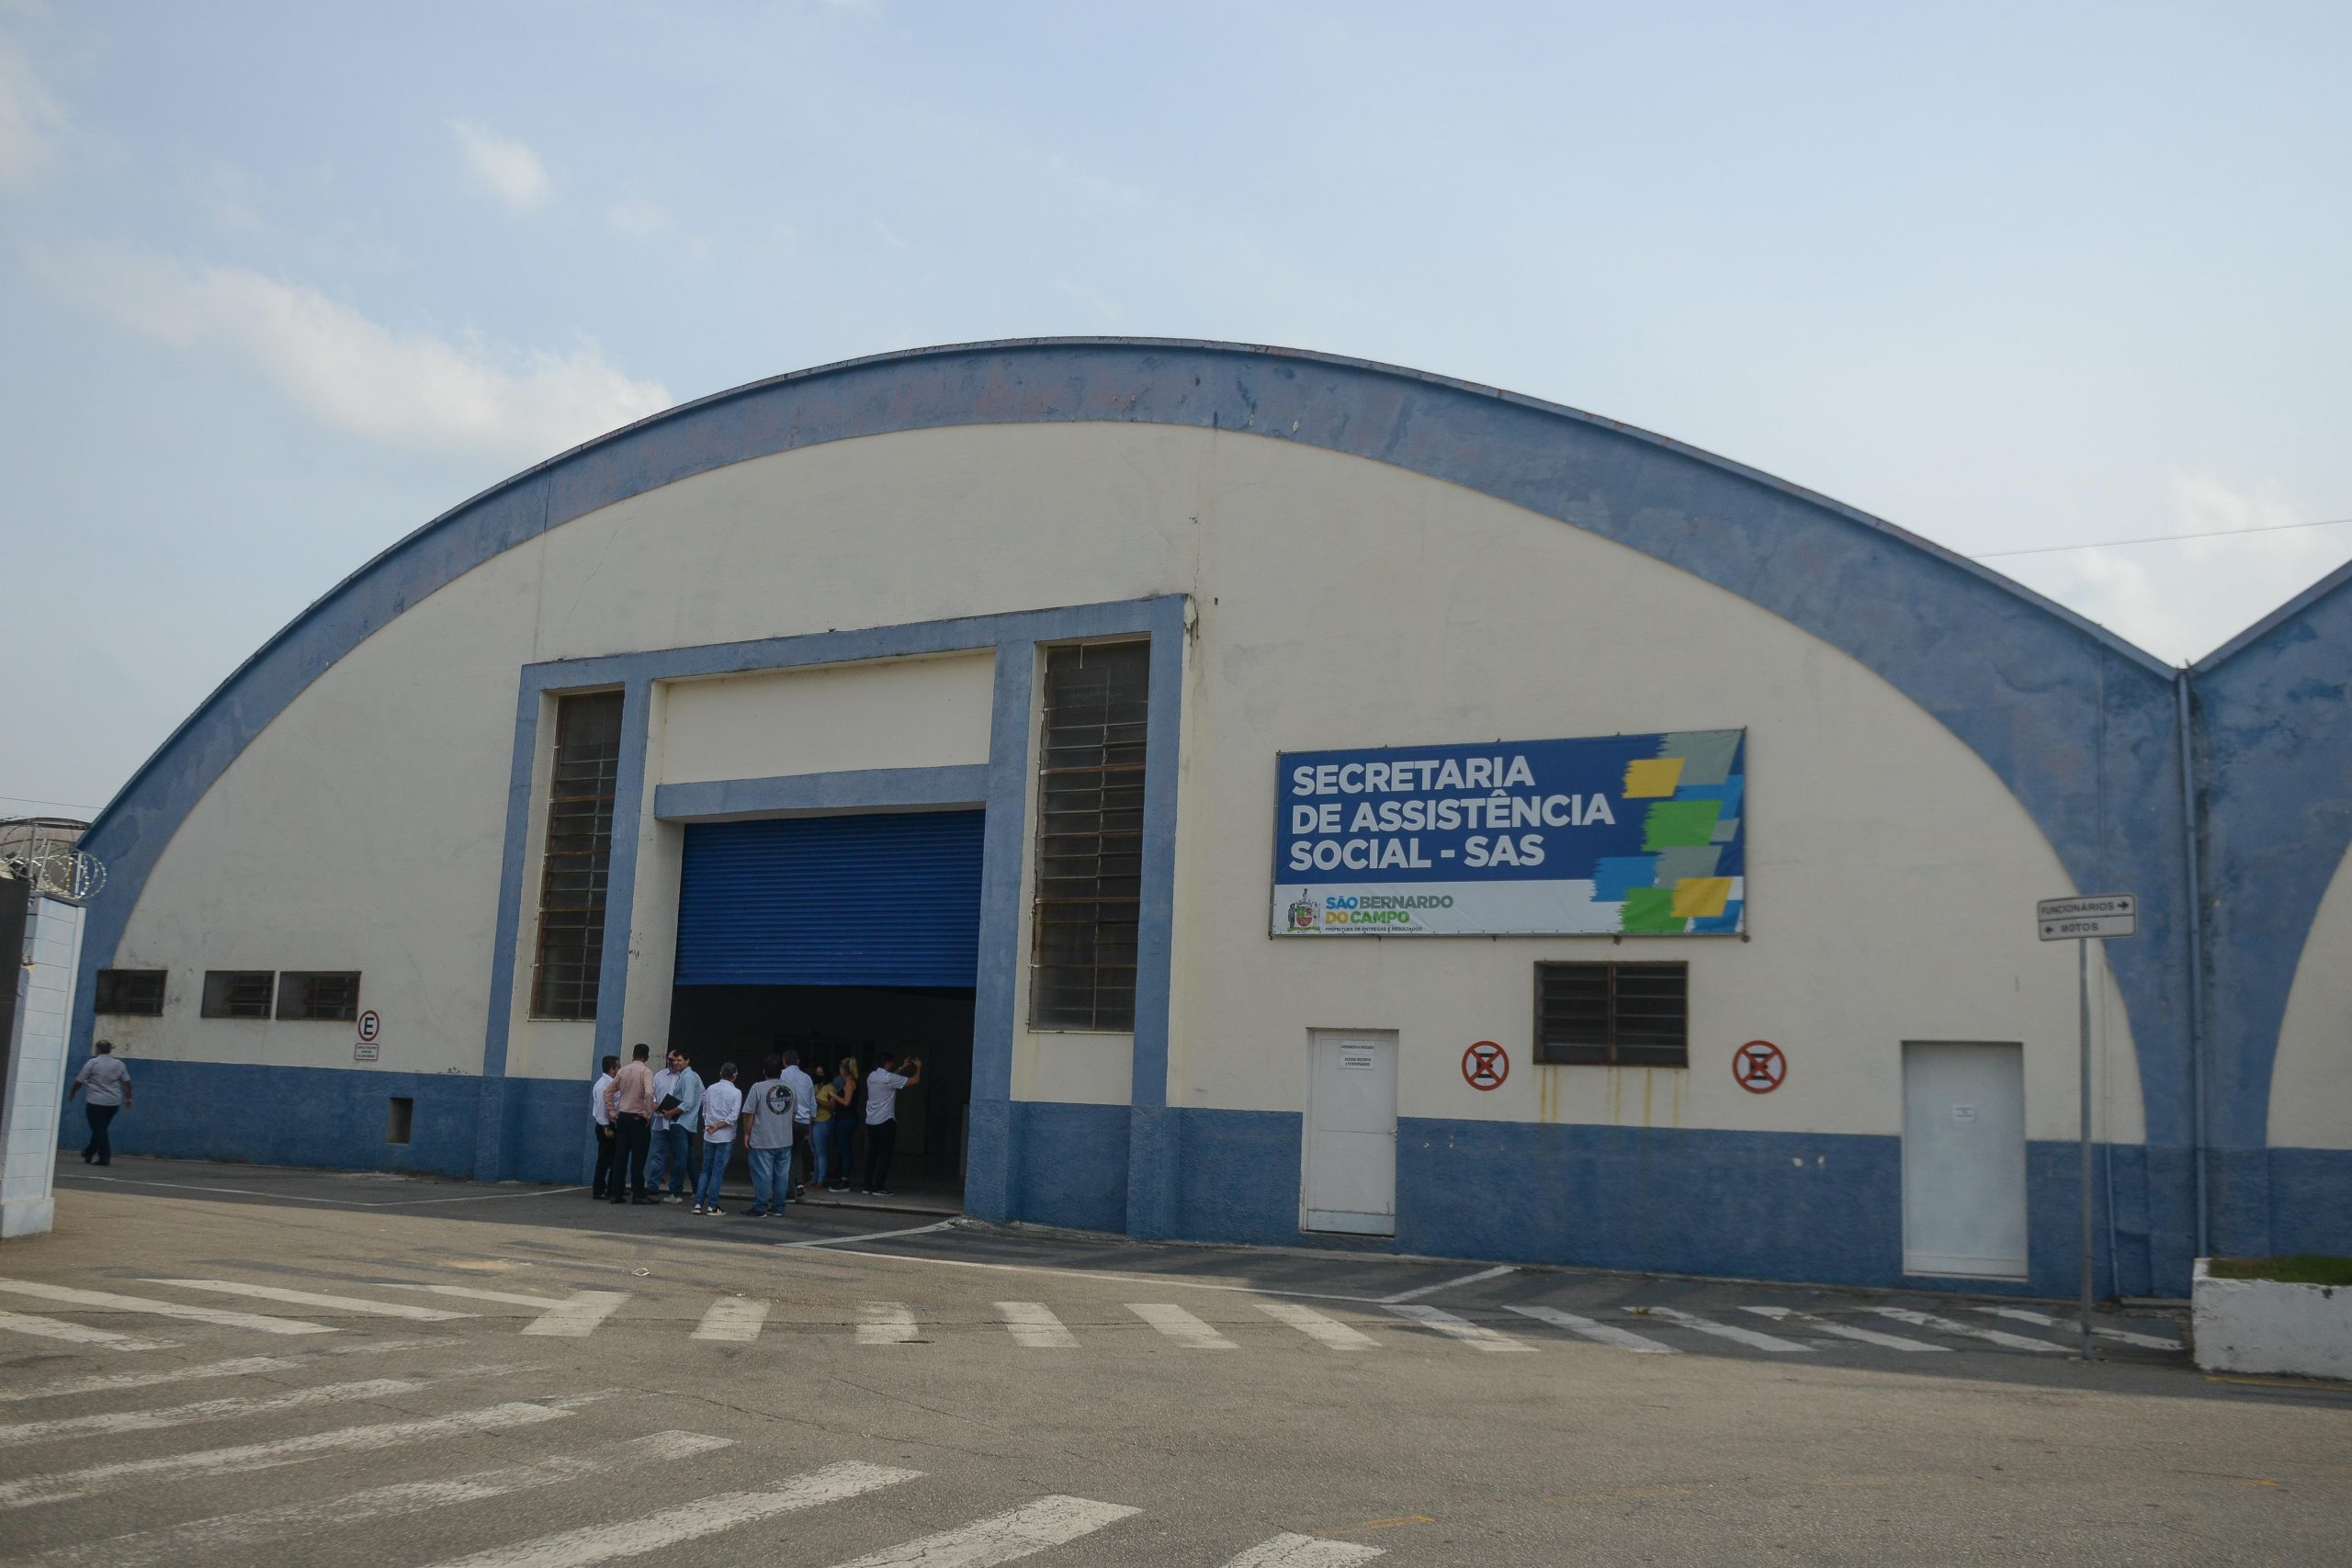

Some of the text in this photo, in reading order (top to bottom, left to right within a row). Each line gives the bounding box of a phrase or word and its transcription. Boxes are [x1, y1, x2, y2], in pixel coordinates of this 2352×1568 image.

[1292, 755, 1535, 795] SECRETARIA
[1292, 788, 1616, 834] DE ASSISTÊNCIA
[1289, 834, 1545, 871] SOCIAL - SAS
[1326, 895, 1453, 909] SÃO BERNARDO
[1325, 910, 1410, 924] DO CAMPO
[2061, 922, 2099, 933] MOTOS
[364, 1016, 375, 1035] E
